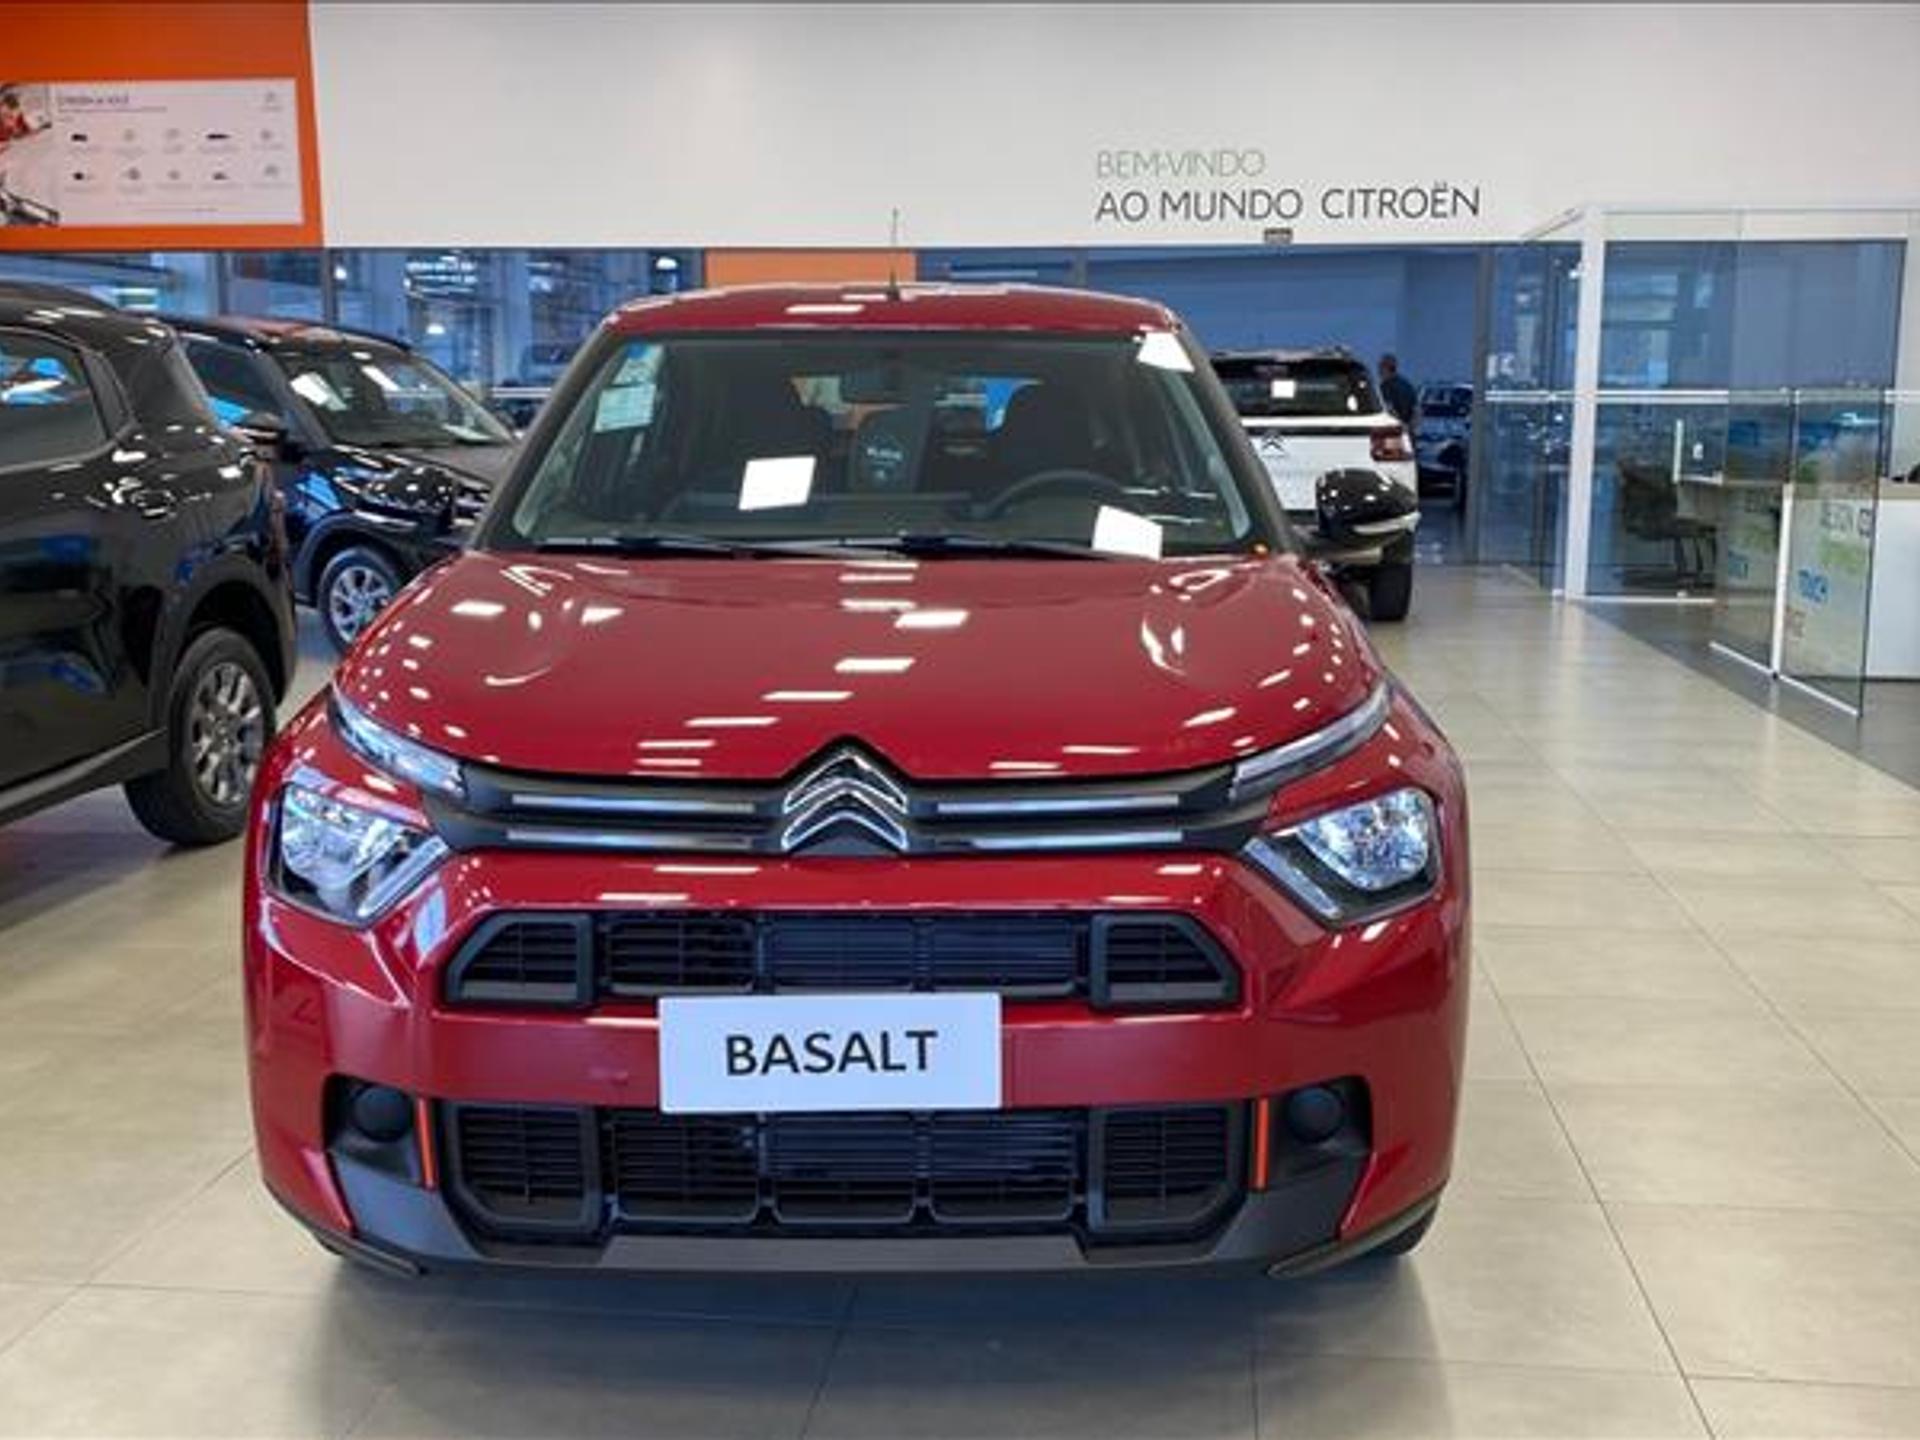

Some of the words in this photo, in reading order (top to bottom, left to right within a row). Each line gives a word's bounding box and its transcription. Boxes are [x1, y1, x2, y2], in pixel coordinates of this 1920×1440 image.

[1095, 190, 1149, 223] AO
[1160, 188, 1304, 222] MUNDO
[1321, 181, 1481, 220] CITROËN
[725, 1030, 938, 1076] BASALT
